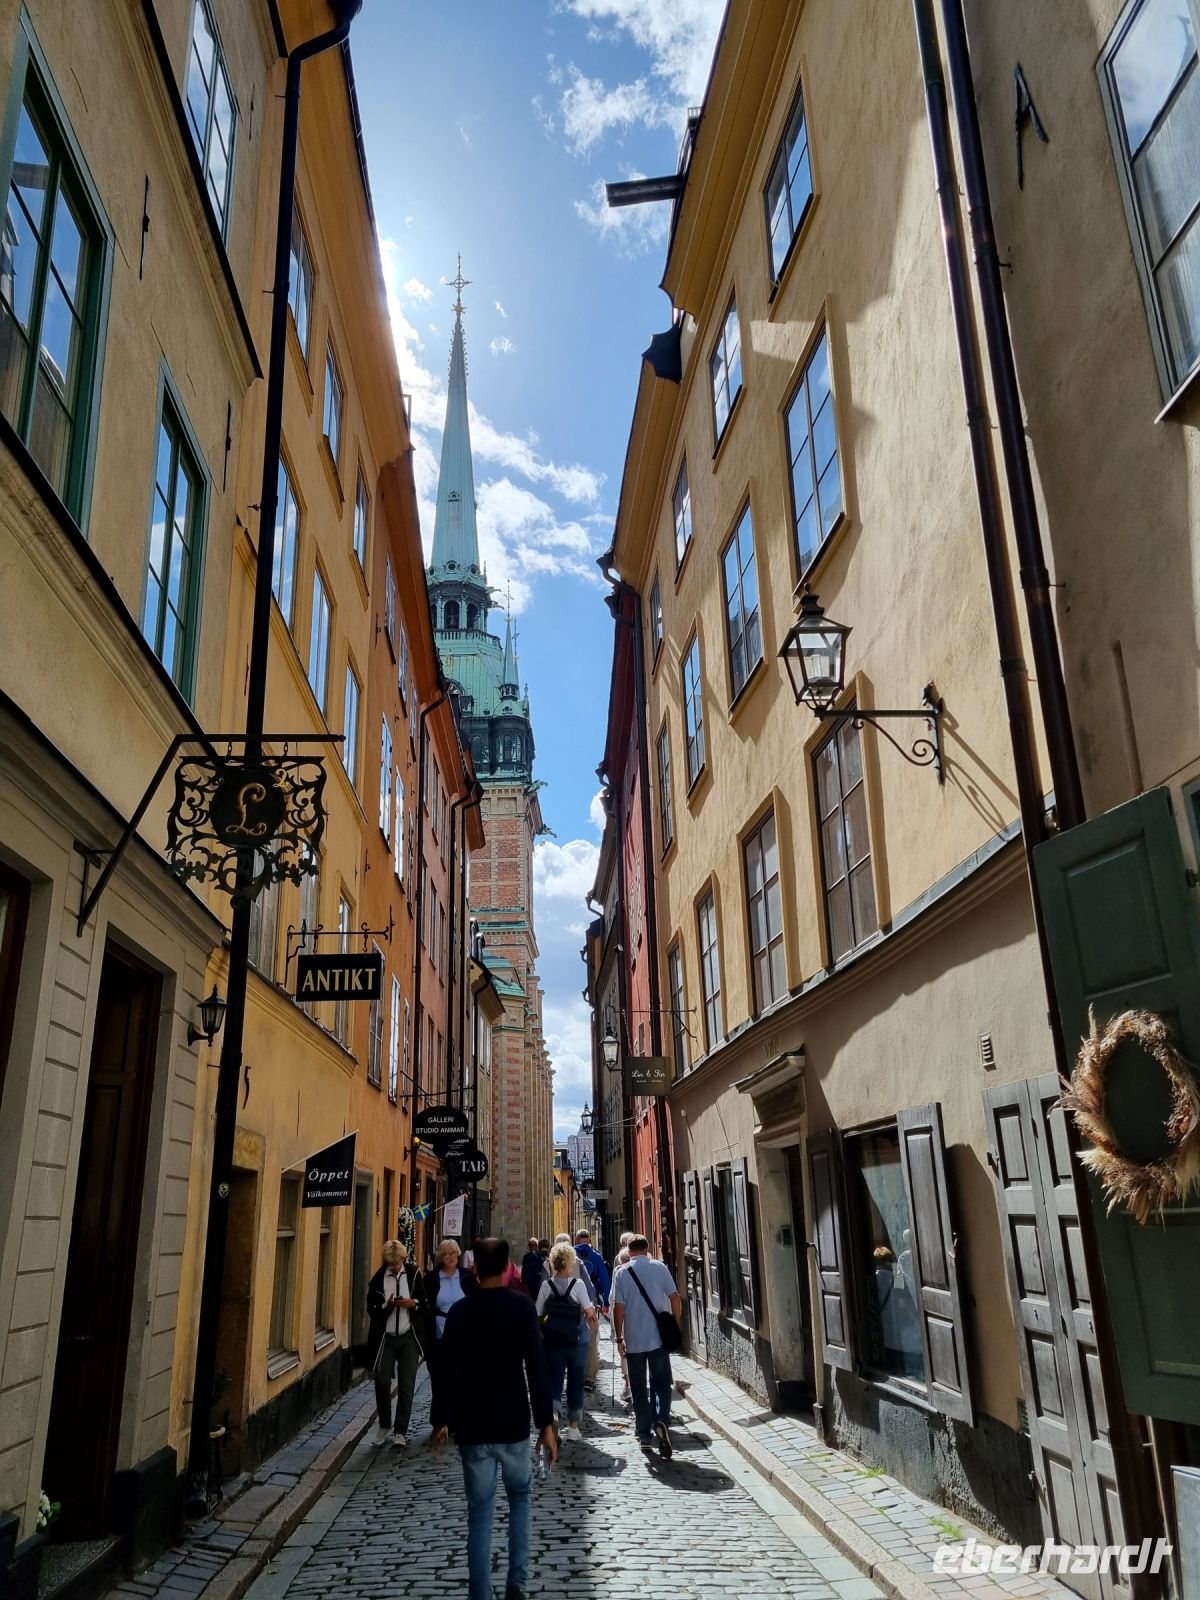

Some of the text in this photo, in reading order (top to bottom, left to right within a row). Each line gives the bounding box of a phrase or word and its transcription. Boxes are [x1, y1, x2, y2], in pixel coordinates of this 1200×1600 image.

[301, 968, 377, 992] ANTIKT
[460, 1160, 486, 1173] TAB
[308, 1168, 350, 1183] Öppet
[307, 1190, 348, 1199] Välkommen
